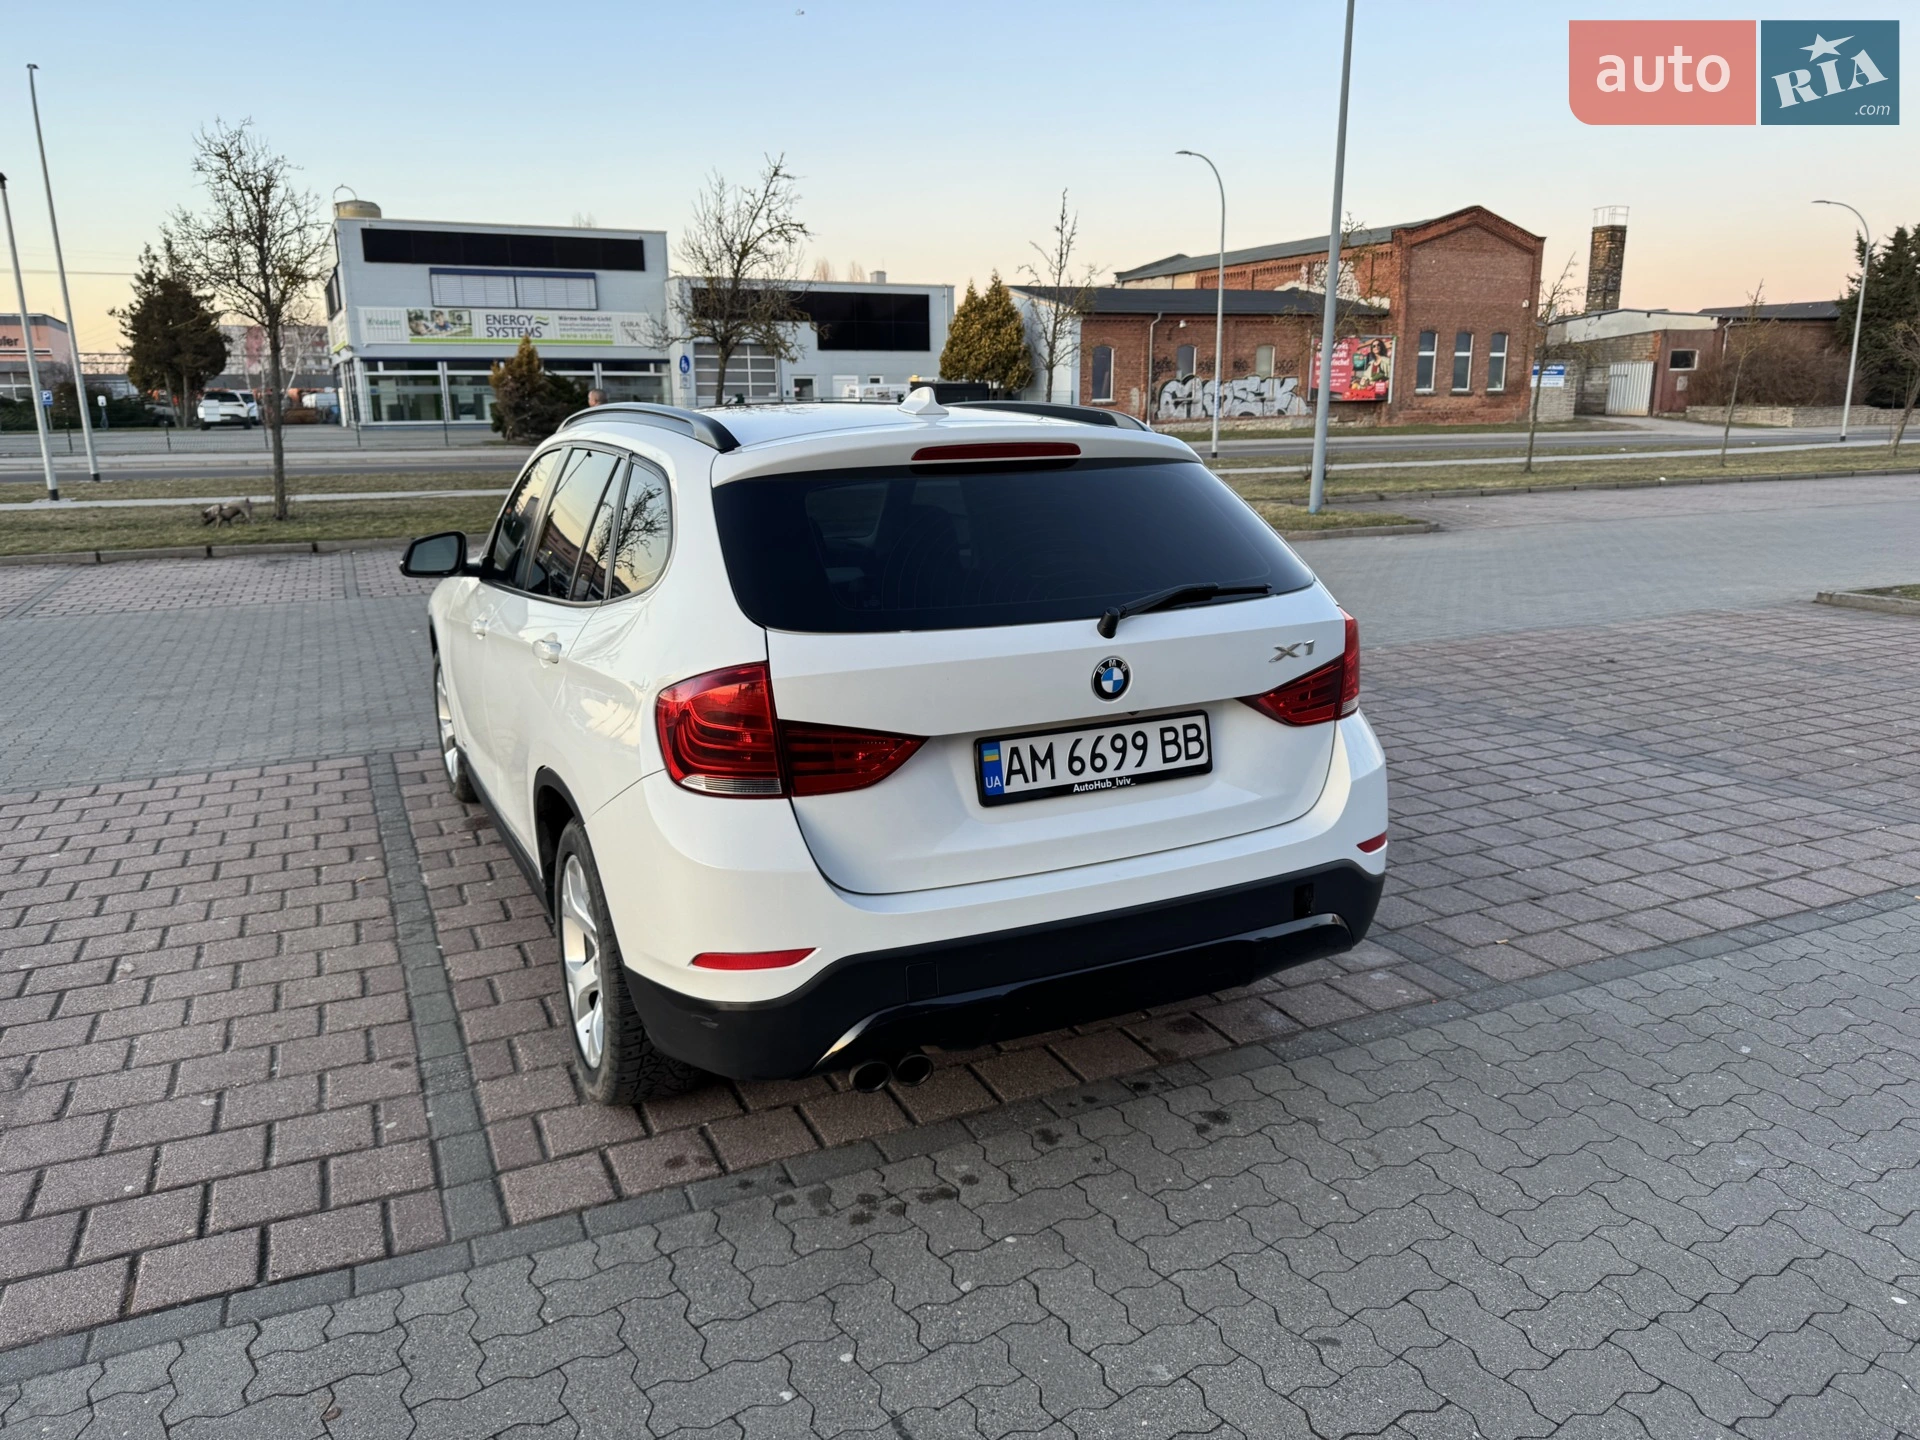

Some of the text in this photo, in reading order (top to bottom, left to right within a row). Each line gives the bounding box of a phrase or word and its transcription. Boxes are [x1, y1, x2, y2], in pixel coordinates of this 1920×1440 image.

[485, 314, 533, 326] ENERGY
[486, 326, 543, 338] SYSTEMS
[1268, 639, 1315, 663] X1
[1097, 659, 1128, 675] BMW
[1004, 723, 1205, 787] AM 6699 BB
[985, 776, 1002, 789] UA
